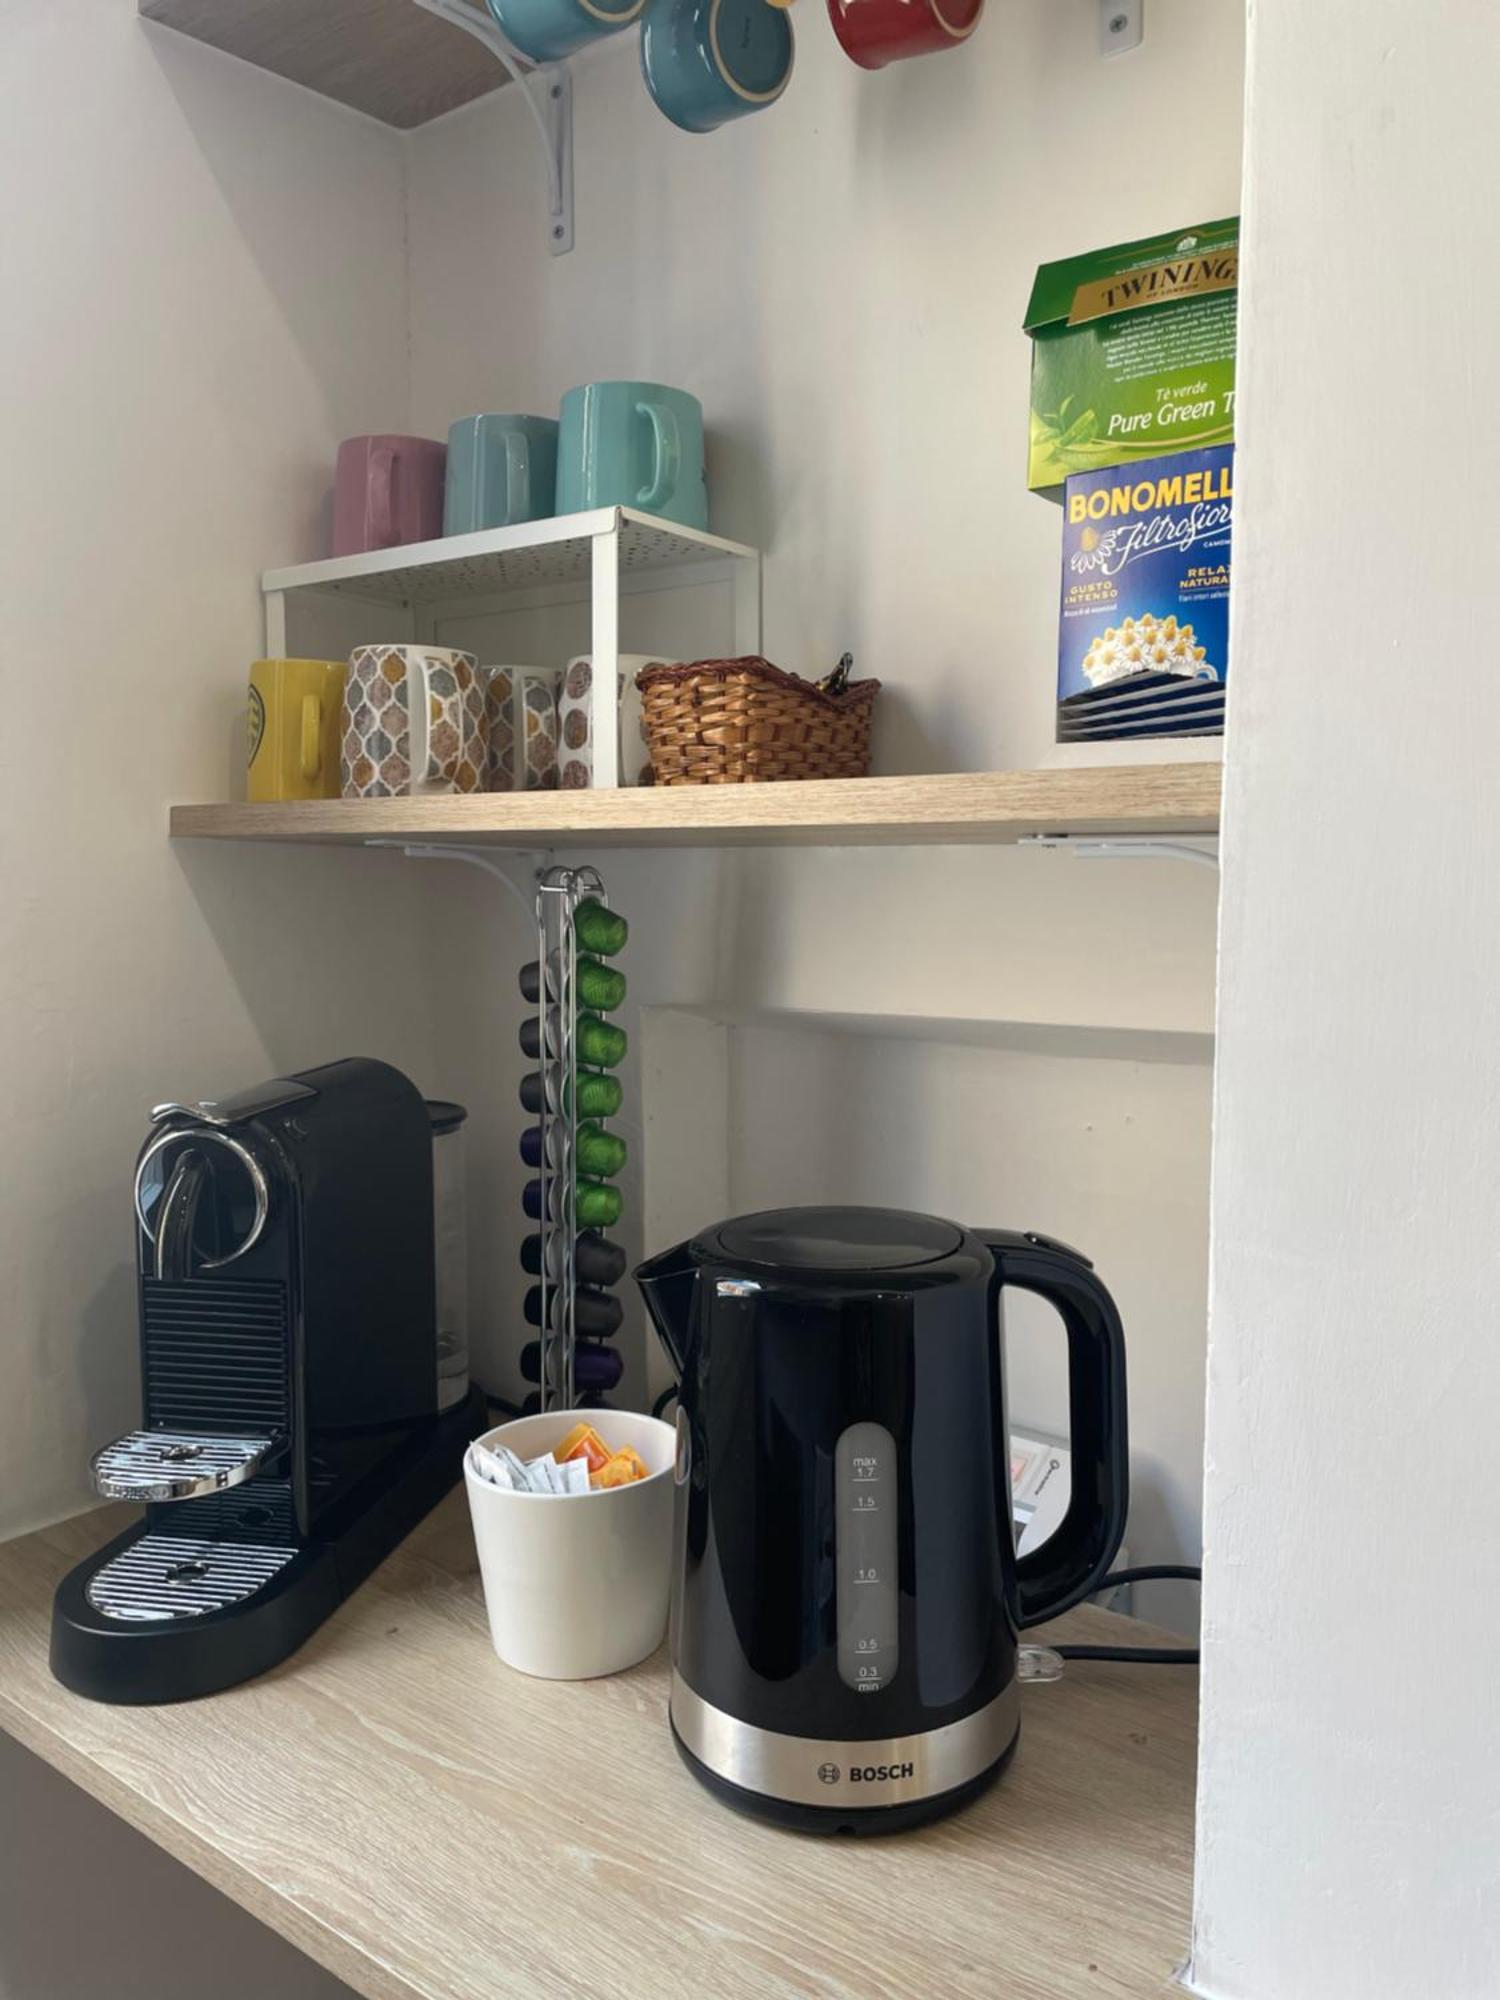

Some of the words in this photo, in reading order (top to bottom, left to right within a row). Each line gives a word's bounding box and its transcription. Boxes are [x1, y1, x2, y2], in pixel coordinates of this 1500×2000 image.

[1101, 258, 1237, 307] TWINING
[1172, 380, 1209, 398] verde
[1106, 411, 1153, 437] Pure
[1157, 399, 1217, 426] Green
[1069, 467, 1233, 524] BONOMELL
[1069, 580, 1113, 595] GUSTO
[1064, 589, 1119, 605] INTENSO
[852, 1457, 878, 1467] max
[858, 1569, 876, 1580] 1.0
[858, 1639, 878, 1650] 0.5
[858, 1682, 880, 1692] min
[849, 1762, 914, 1782] BOSCH
